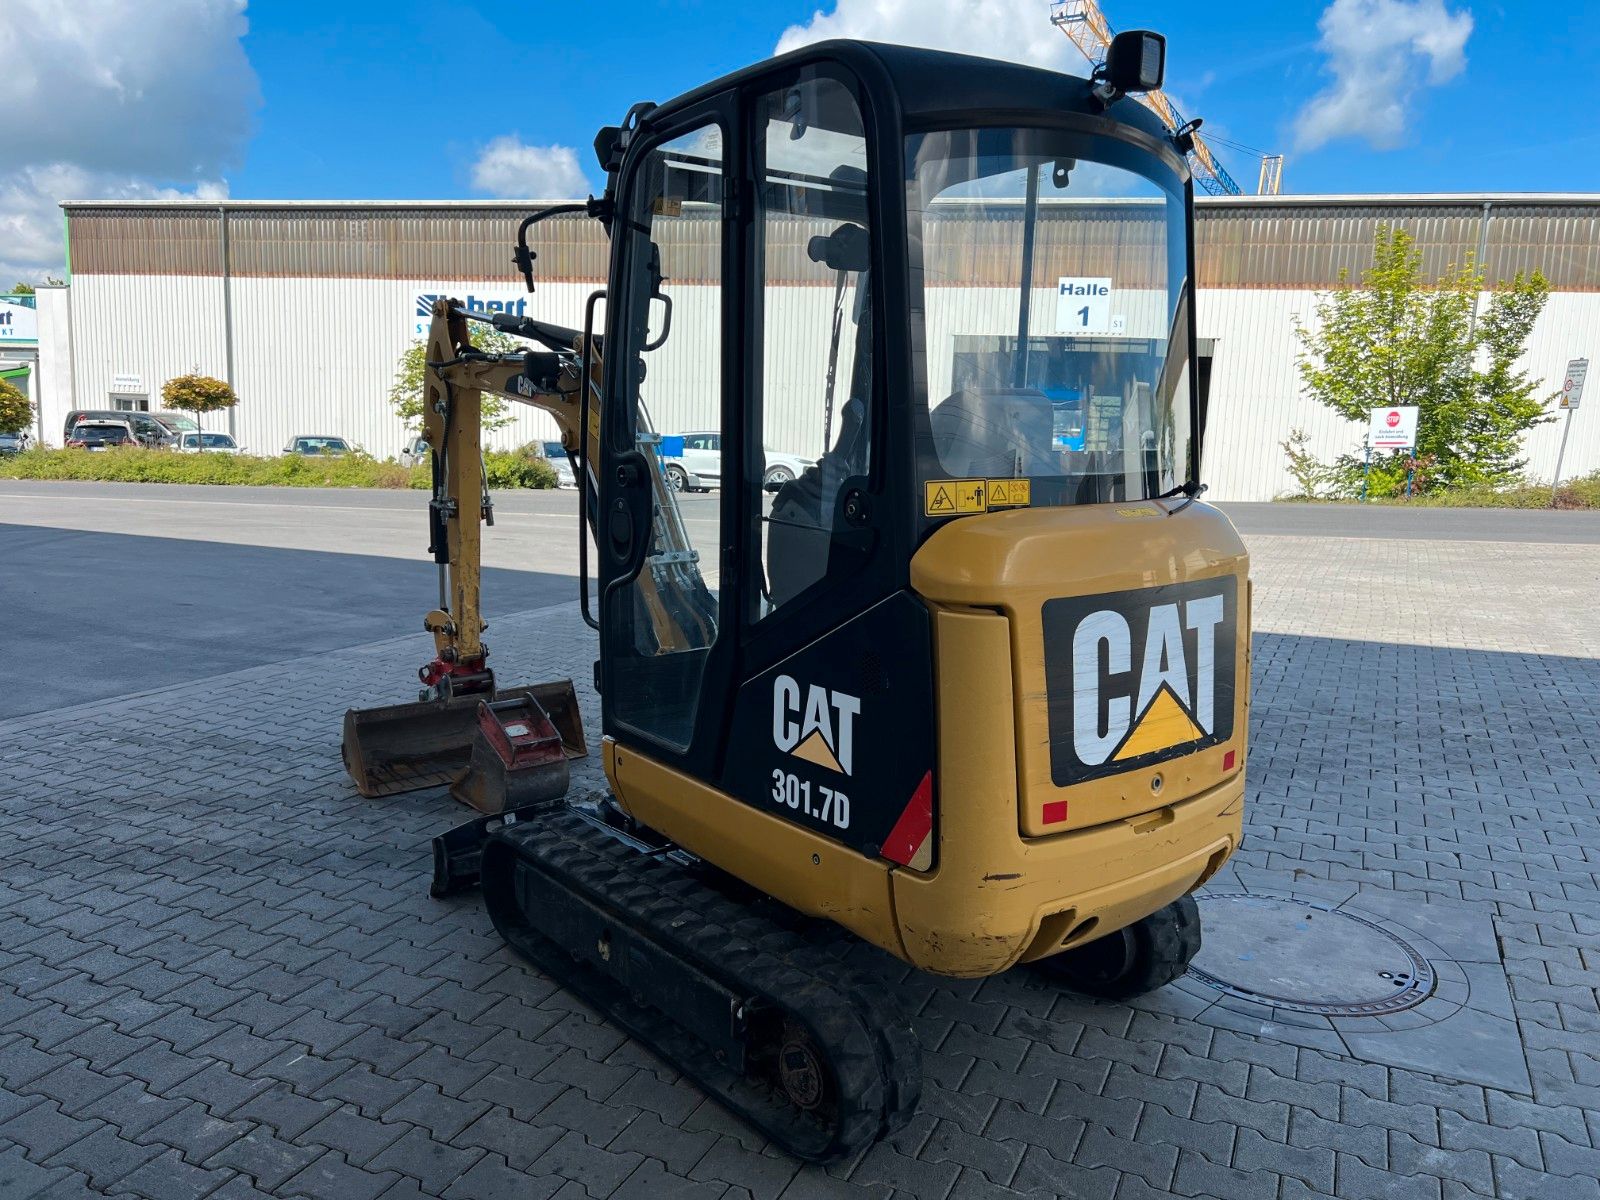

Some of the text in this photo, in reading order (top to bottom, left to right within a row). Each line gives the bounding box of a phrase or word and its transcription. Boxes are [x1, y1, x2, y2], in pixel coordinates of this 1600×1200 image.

[1060, 283, 1109, 296] Halle
[1077, 305, 1090, 327] 1
[1072, 594, 1224, 766] CAT
[773, 674, 861, 777] CAT
[772, 768, 850, 829] 301.7D
